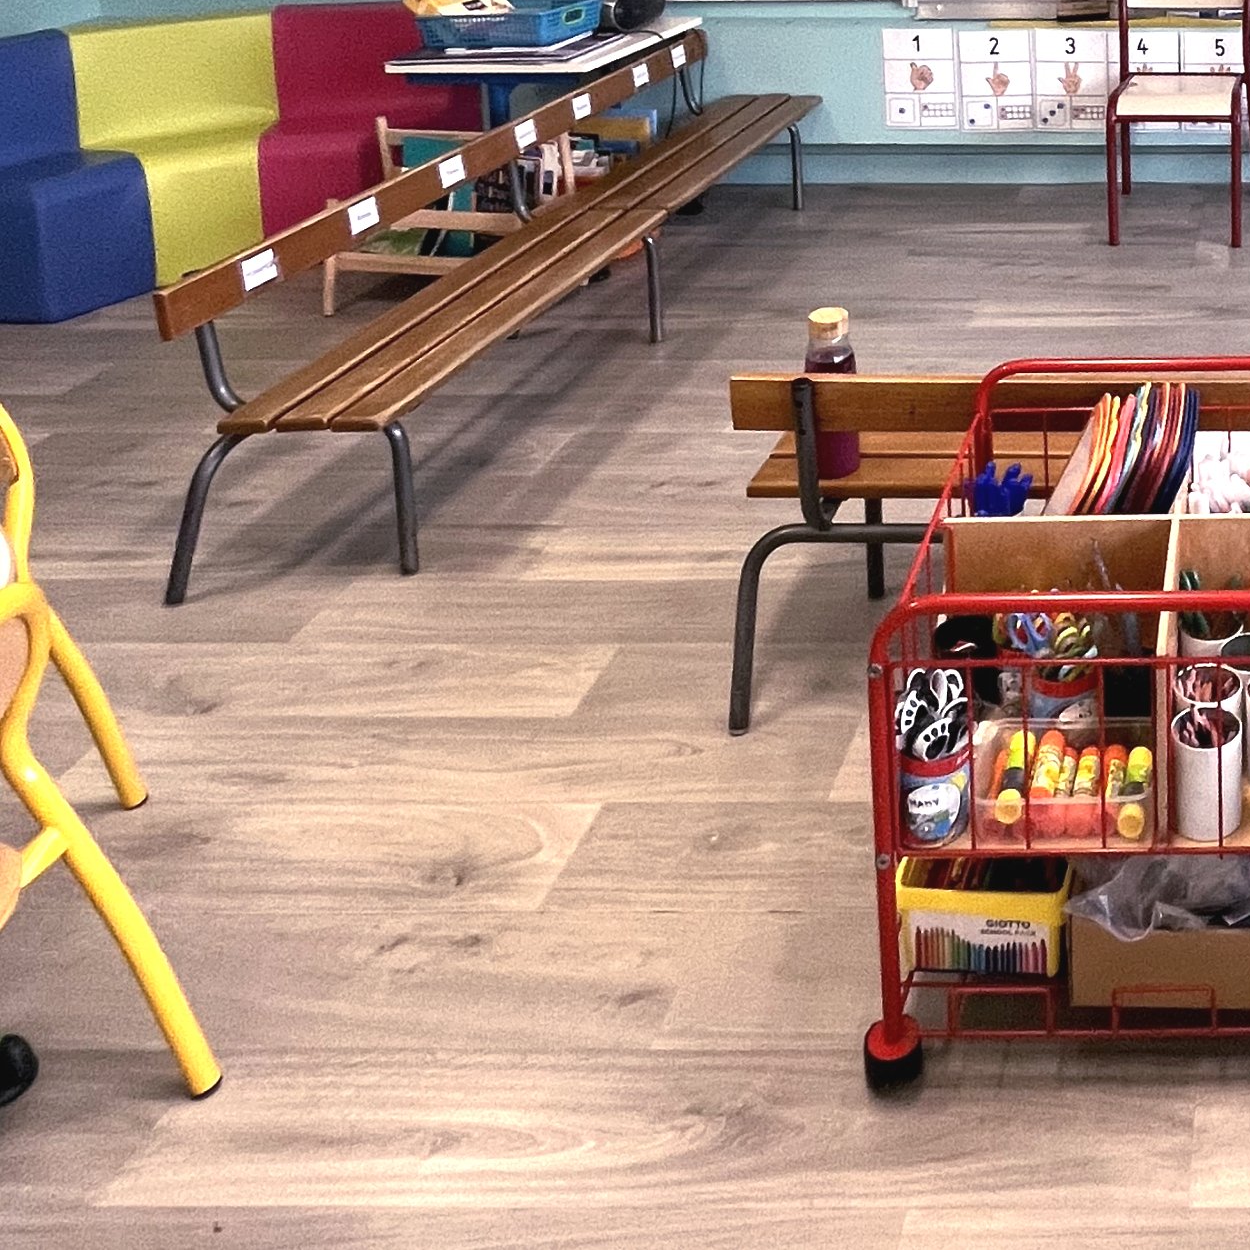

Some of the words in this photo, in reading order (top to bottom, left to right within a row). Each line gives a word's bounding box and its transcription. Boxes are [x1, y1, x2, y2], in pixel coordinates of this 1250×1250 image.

[912, 35, 919, 51] 1
[989, 37, 999, 55] 2
[1066, 37, 1075, 54] 3
[1137, 38, 1148, 55] 4
[1216, 39, 1225, 56] 5
[986, 920, 1030, 929] GIOTTO
